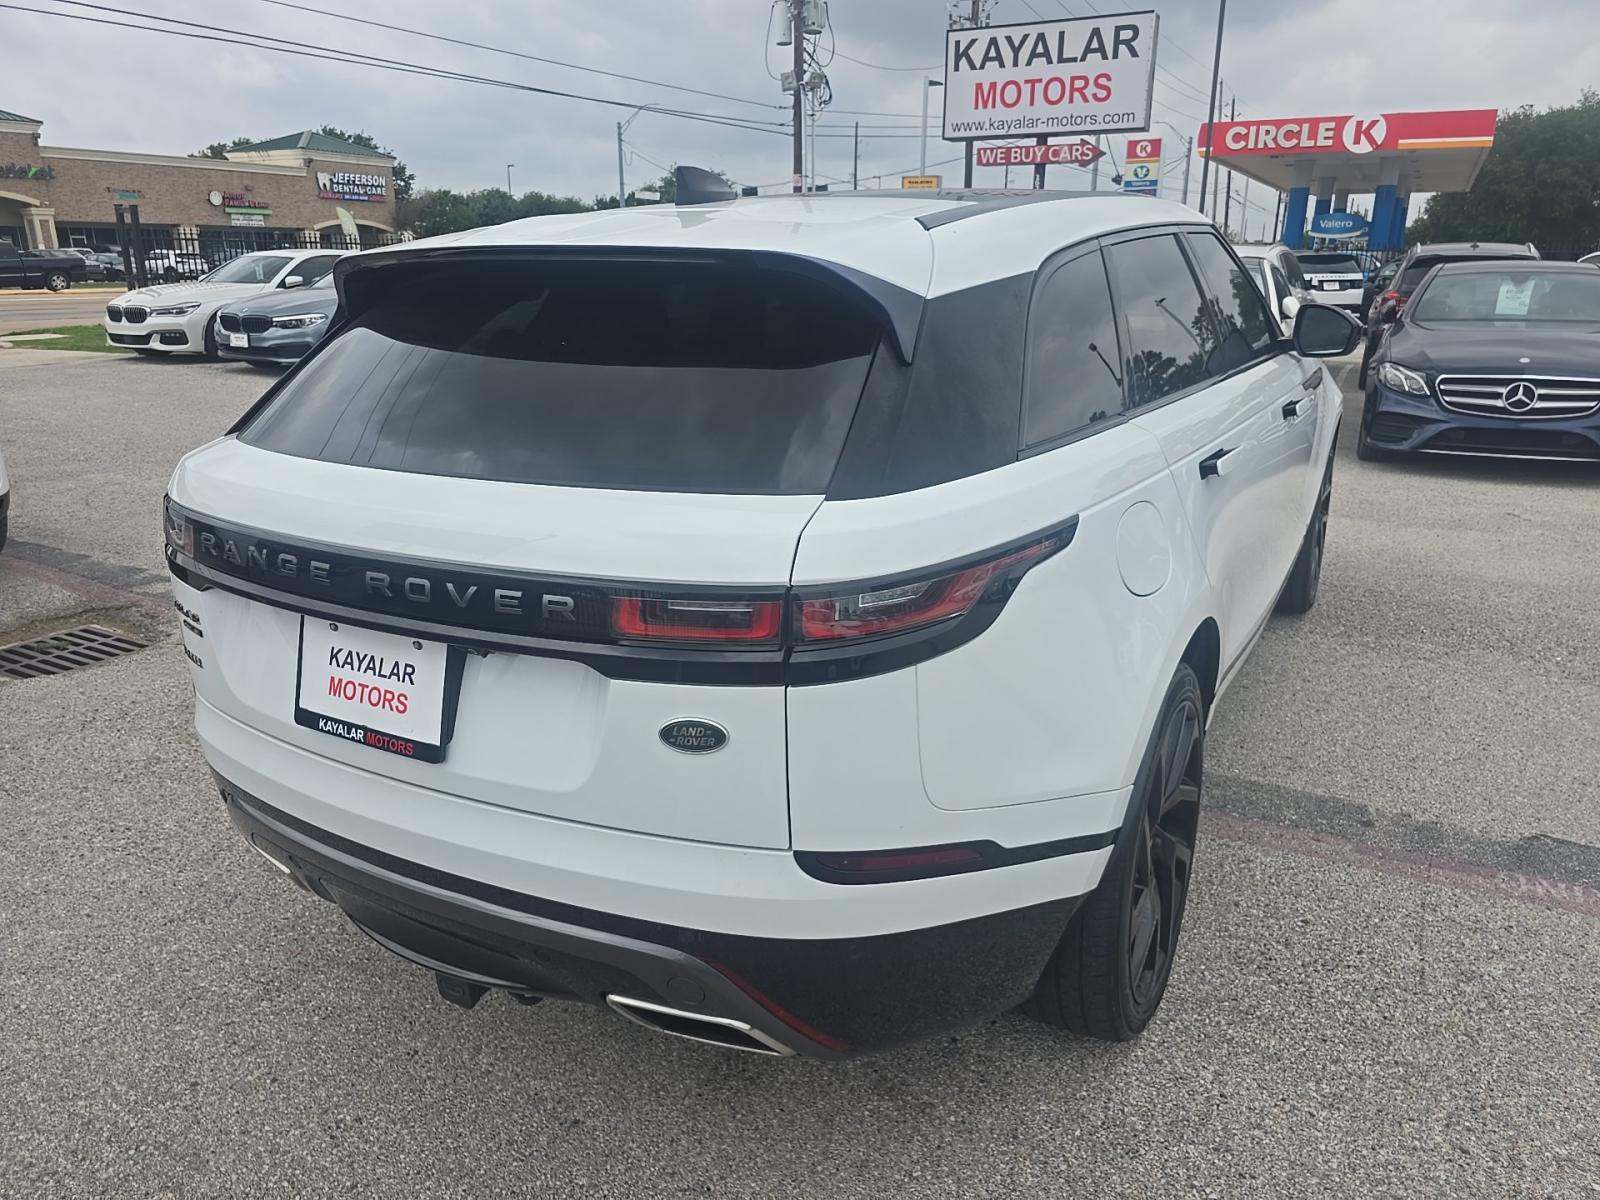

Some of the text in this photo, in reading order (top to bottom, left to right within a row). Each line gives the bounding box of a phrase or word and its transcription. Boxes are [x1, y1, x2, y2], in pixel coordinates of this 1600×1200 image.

[953, 23, 1140, 72] KAYALAR
[973, 73, 1113, 110] MOTORS
[951, 110, 1135, 134] www.kayalar-motors.com
[1225, 119, 1380, 150] CIRCLE K
[980, 144, 1093, 164] WE BUY CARS
[331, 172, 386, 186] JEFFERSON
[332, 184, 386, 195] DENTAL CARE
[1319, 219, 1353, 229] Valero
[200, 531, 577, 622] RANGE ROVER
[328, 645, 416, 686] KAYALAR
[328, 675, 409, 715] MOTORS
[318, 717, 414, 756] KAYALAR MOTORS
